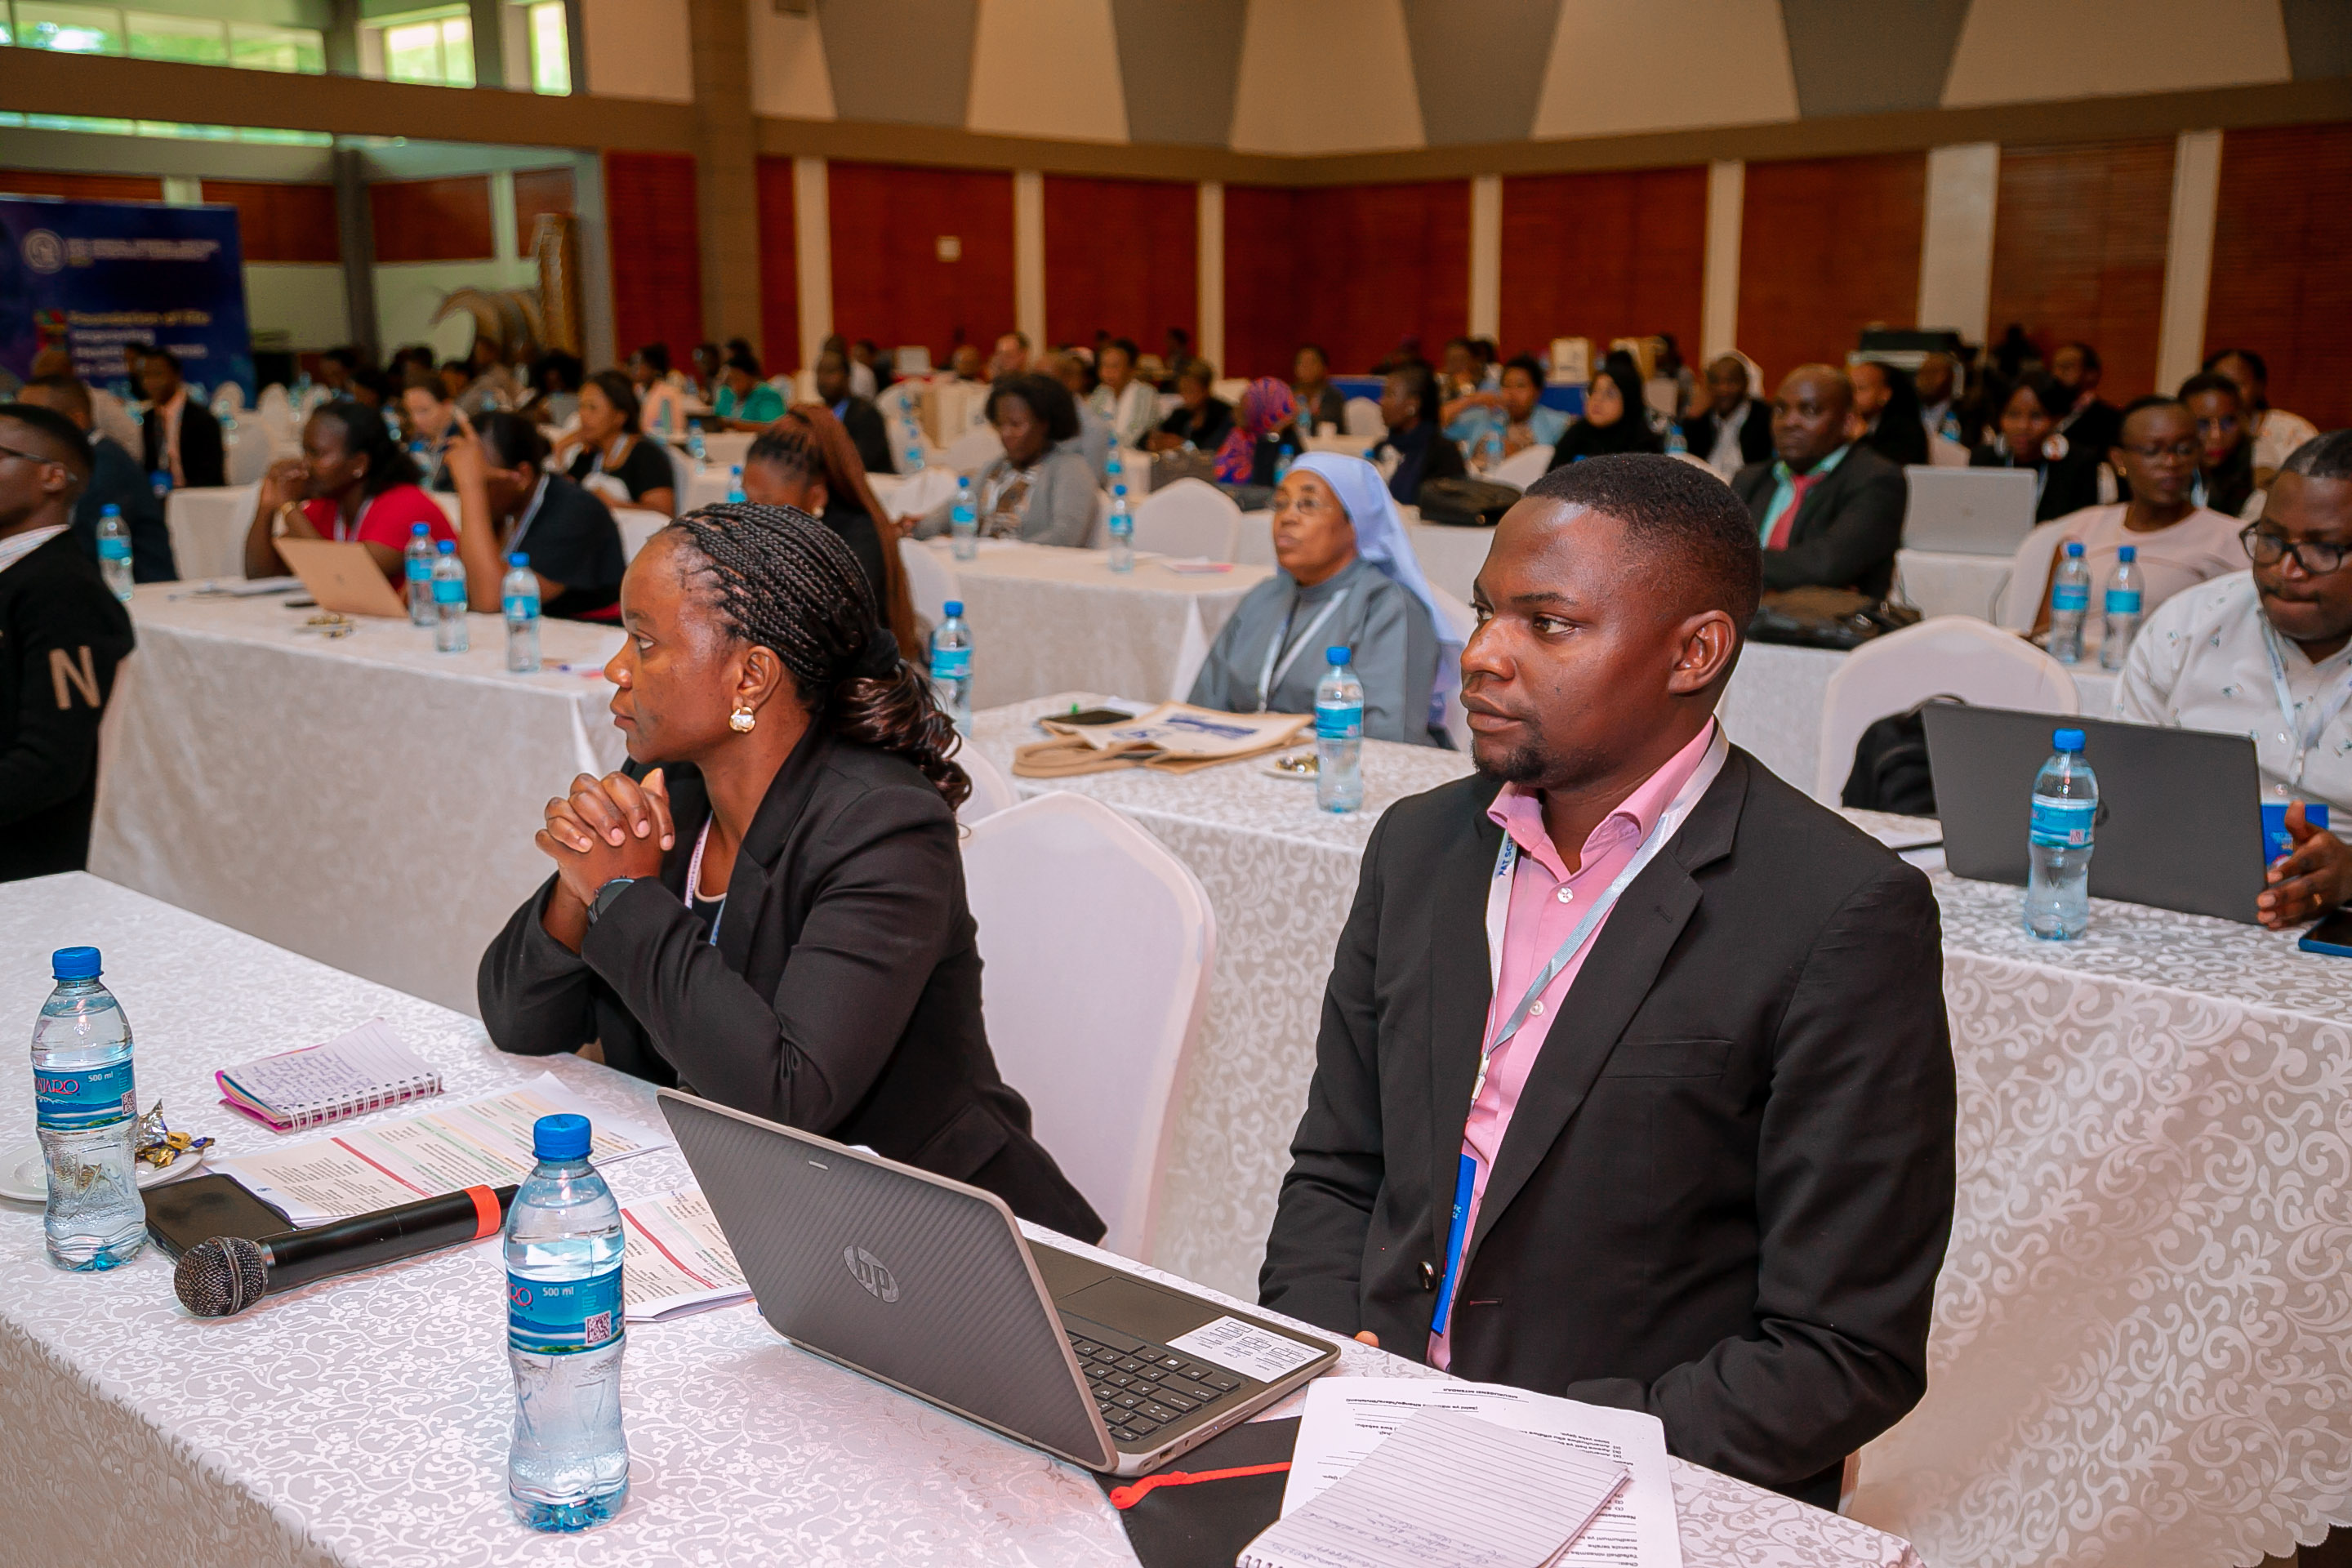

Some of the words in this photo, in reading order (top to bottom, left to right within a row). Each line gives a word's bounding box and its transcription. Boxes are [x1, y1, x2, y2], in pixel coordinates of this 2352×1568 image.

[49, 645, 100, 710] N
[88, 1073, 102, 1083] 500
[104, 1071, 114, 1080] ml
[849, 1245, 893, 1300] hp
[542, 1286, 559, 1297] 500
[562, 1285, 574, 1296] ml
